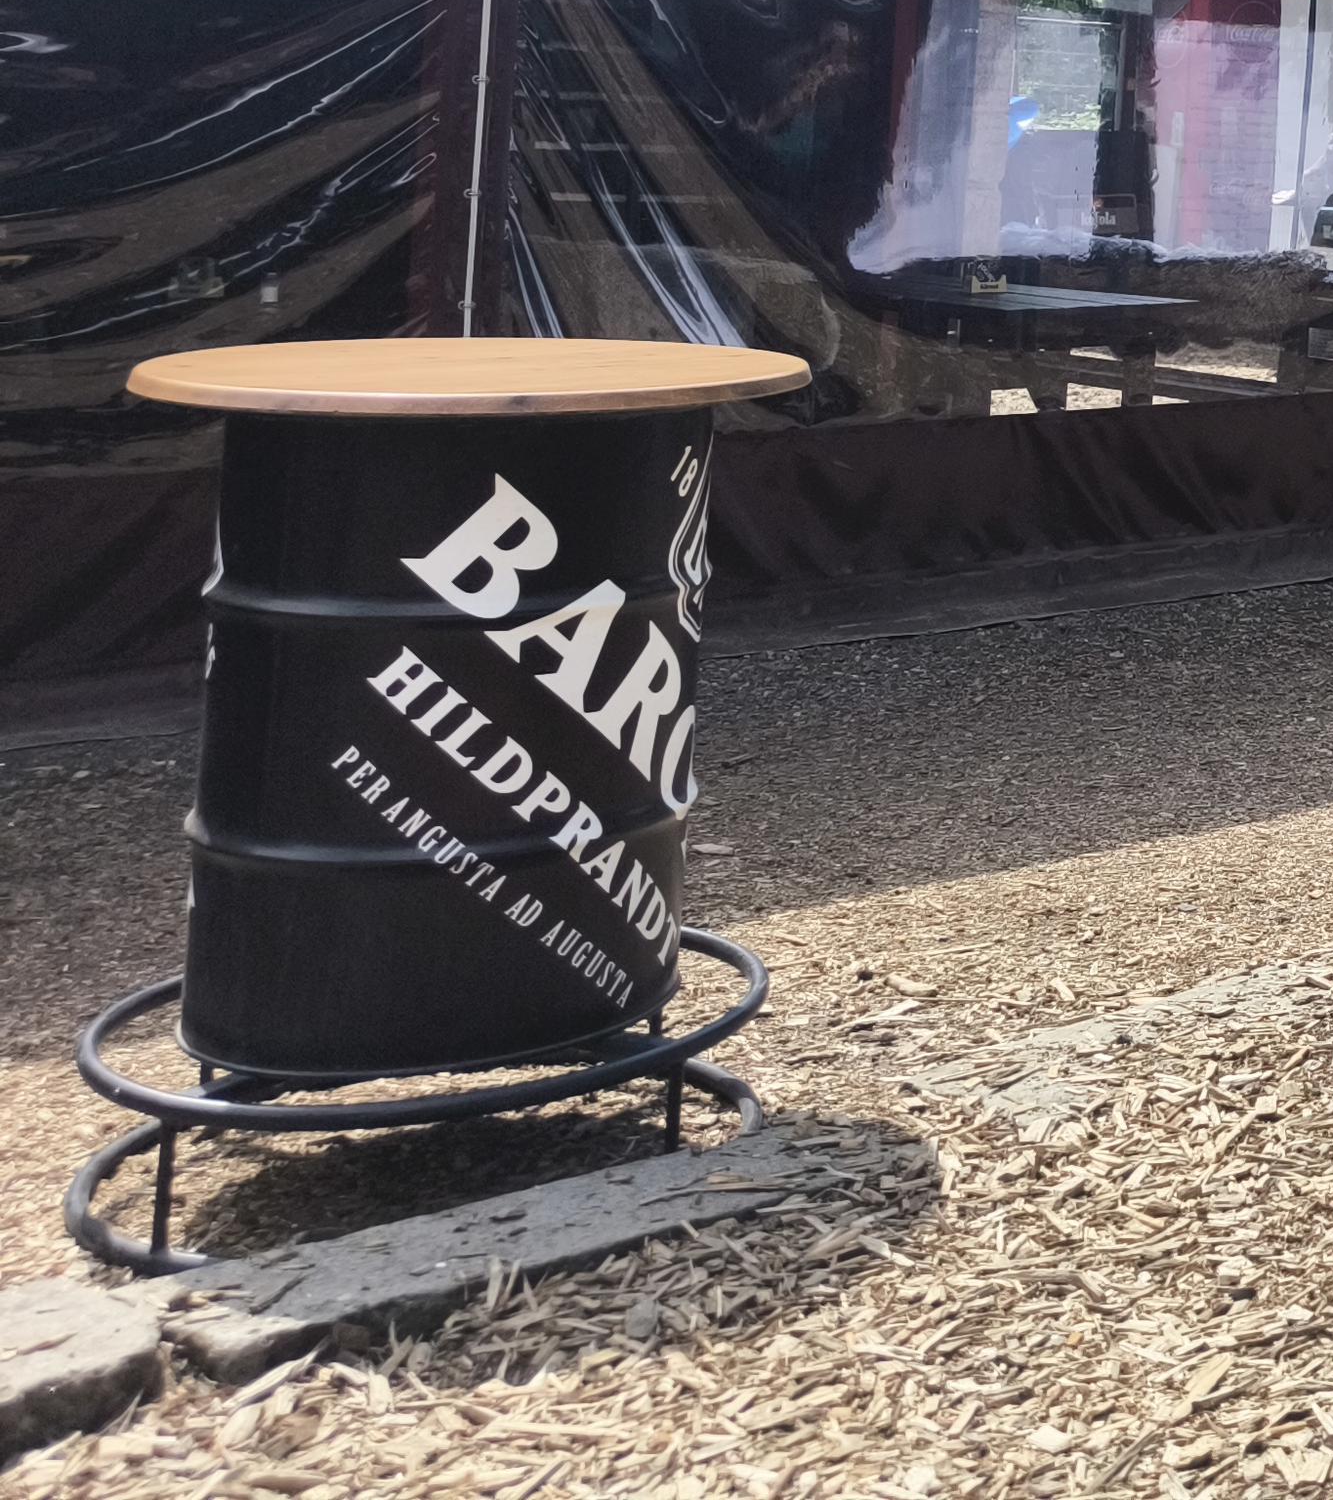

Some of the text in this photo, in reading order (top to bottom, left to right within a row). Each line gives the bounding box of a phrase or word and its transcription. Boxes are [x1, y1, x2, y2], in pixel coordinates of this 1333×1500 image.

[329, 744, 636, 1011] PER ANGUSTA AD AUGUSTA
[366, 645, 680, 970] HILDPRANDT
